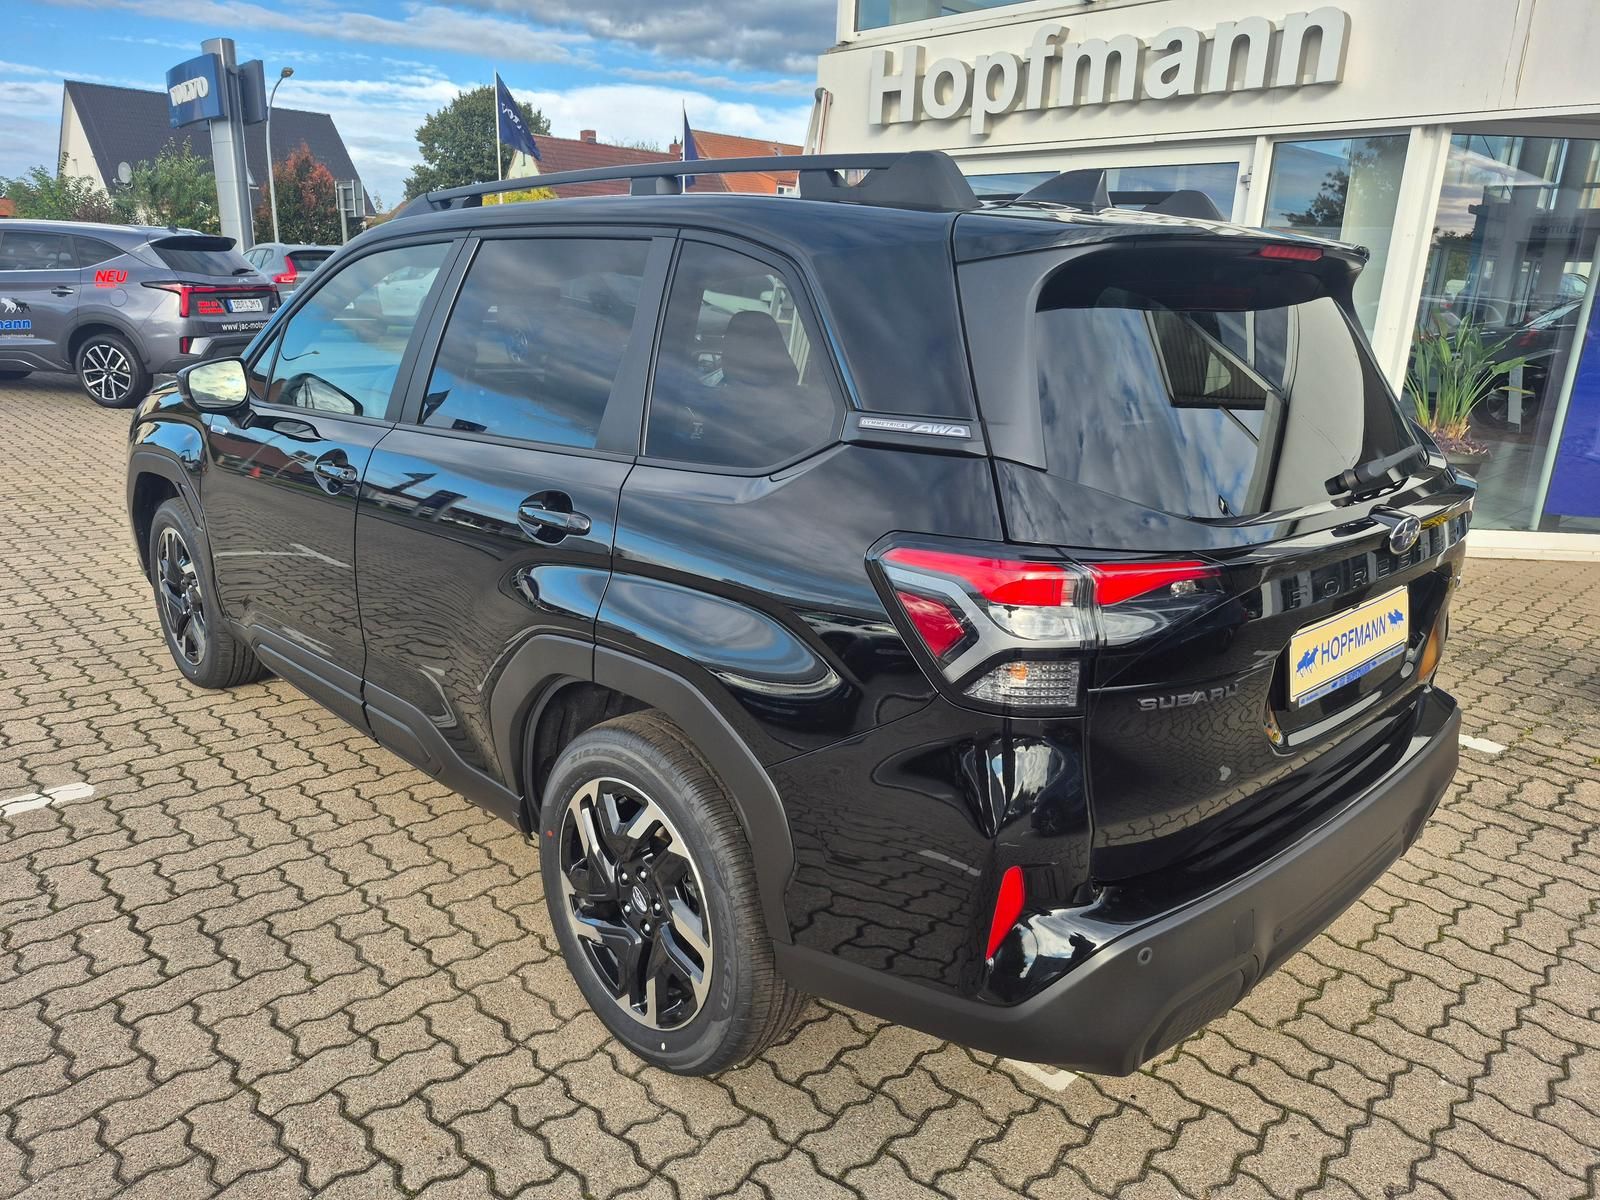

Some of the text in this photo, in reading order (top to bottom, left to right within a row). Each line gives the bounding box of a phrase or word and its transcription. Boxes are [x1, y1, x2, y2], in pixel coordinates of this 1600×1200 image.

[869, 6, 1351, 135] Hopfmann
[95, 270, 128, 284] NEU
[912, 424, 967, 436] AWD
[1321, 613, 1386, 665] HOPFMANN
[1137, 683, 1239, 712] SUBARU
